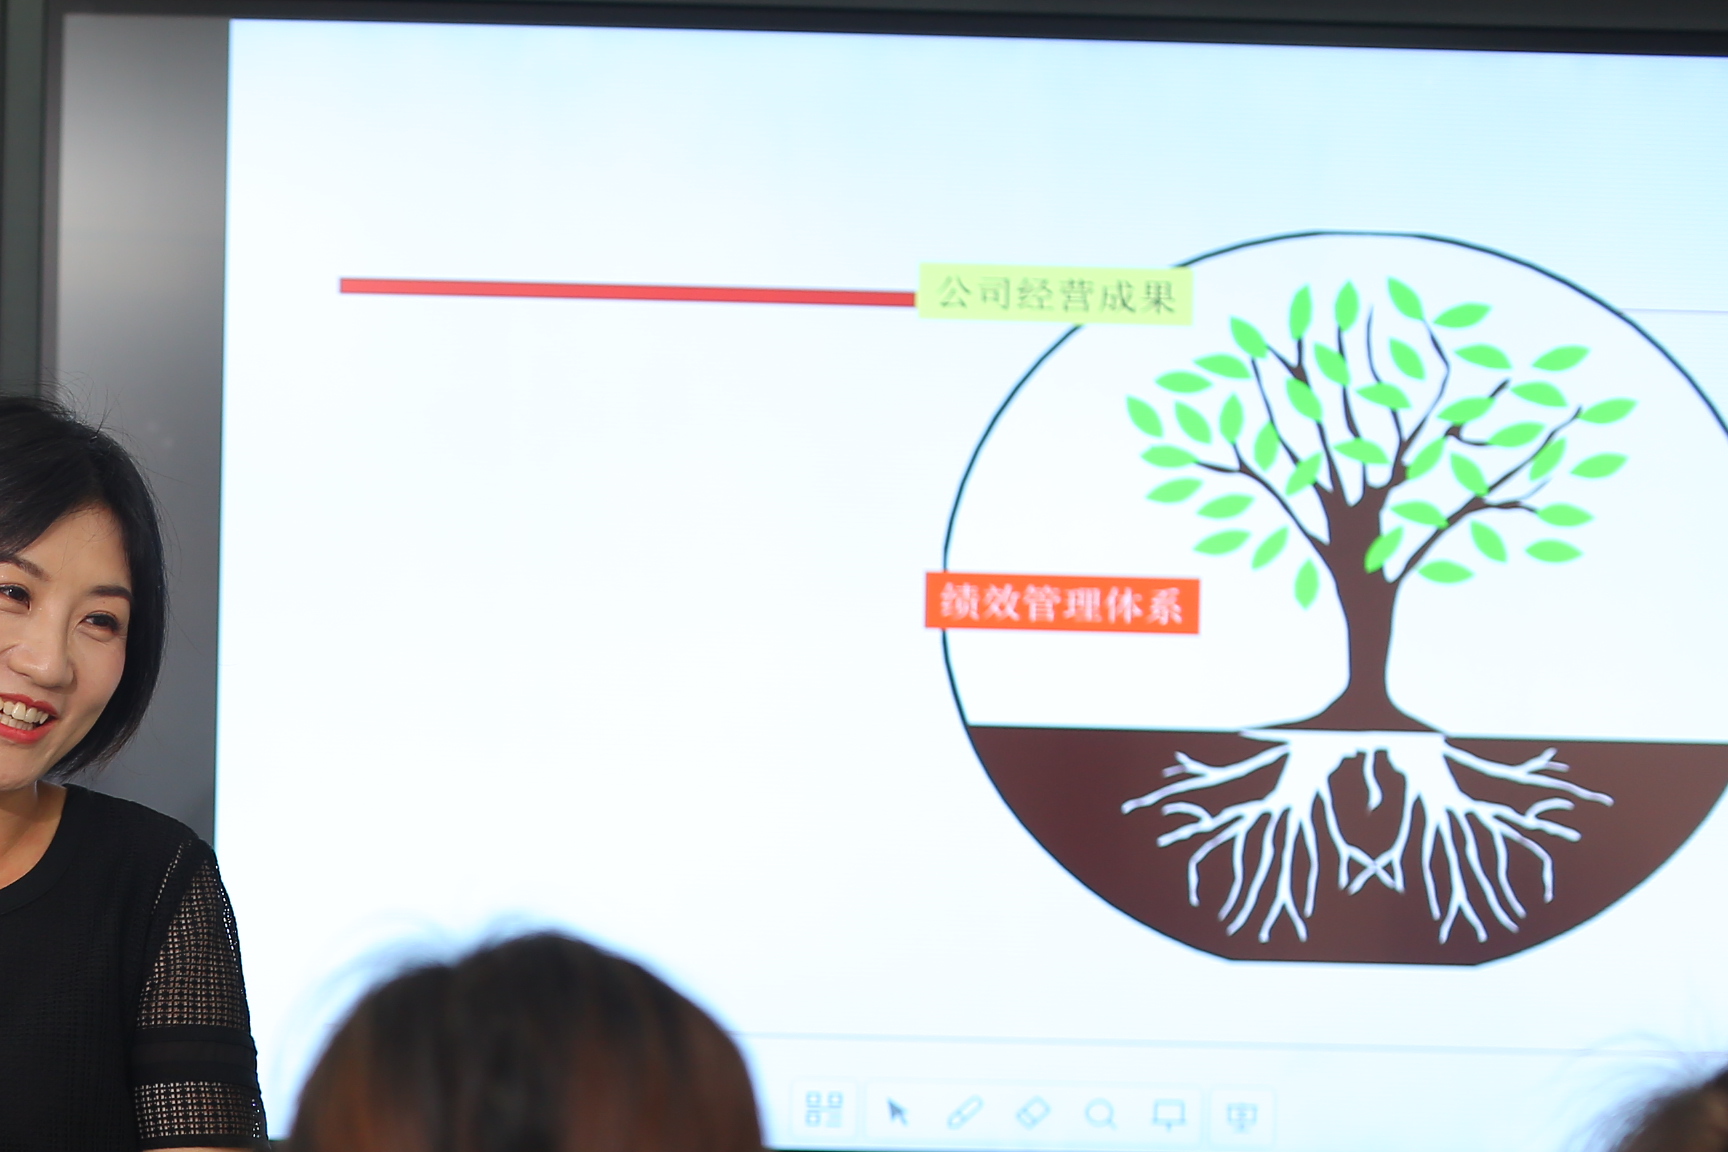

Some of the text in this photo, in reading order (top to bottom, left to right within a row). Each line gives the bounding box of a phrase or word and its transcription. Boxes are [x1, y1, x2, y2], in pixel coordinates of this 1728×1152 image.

[938, 275, 1176, 314] 公司经营成果
[940, 581, 1183, 625] 绩效管理体系
